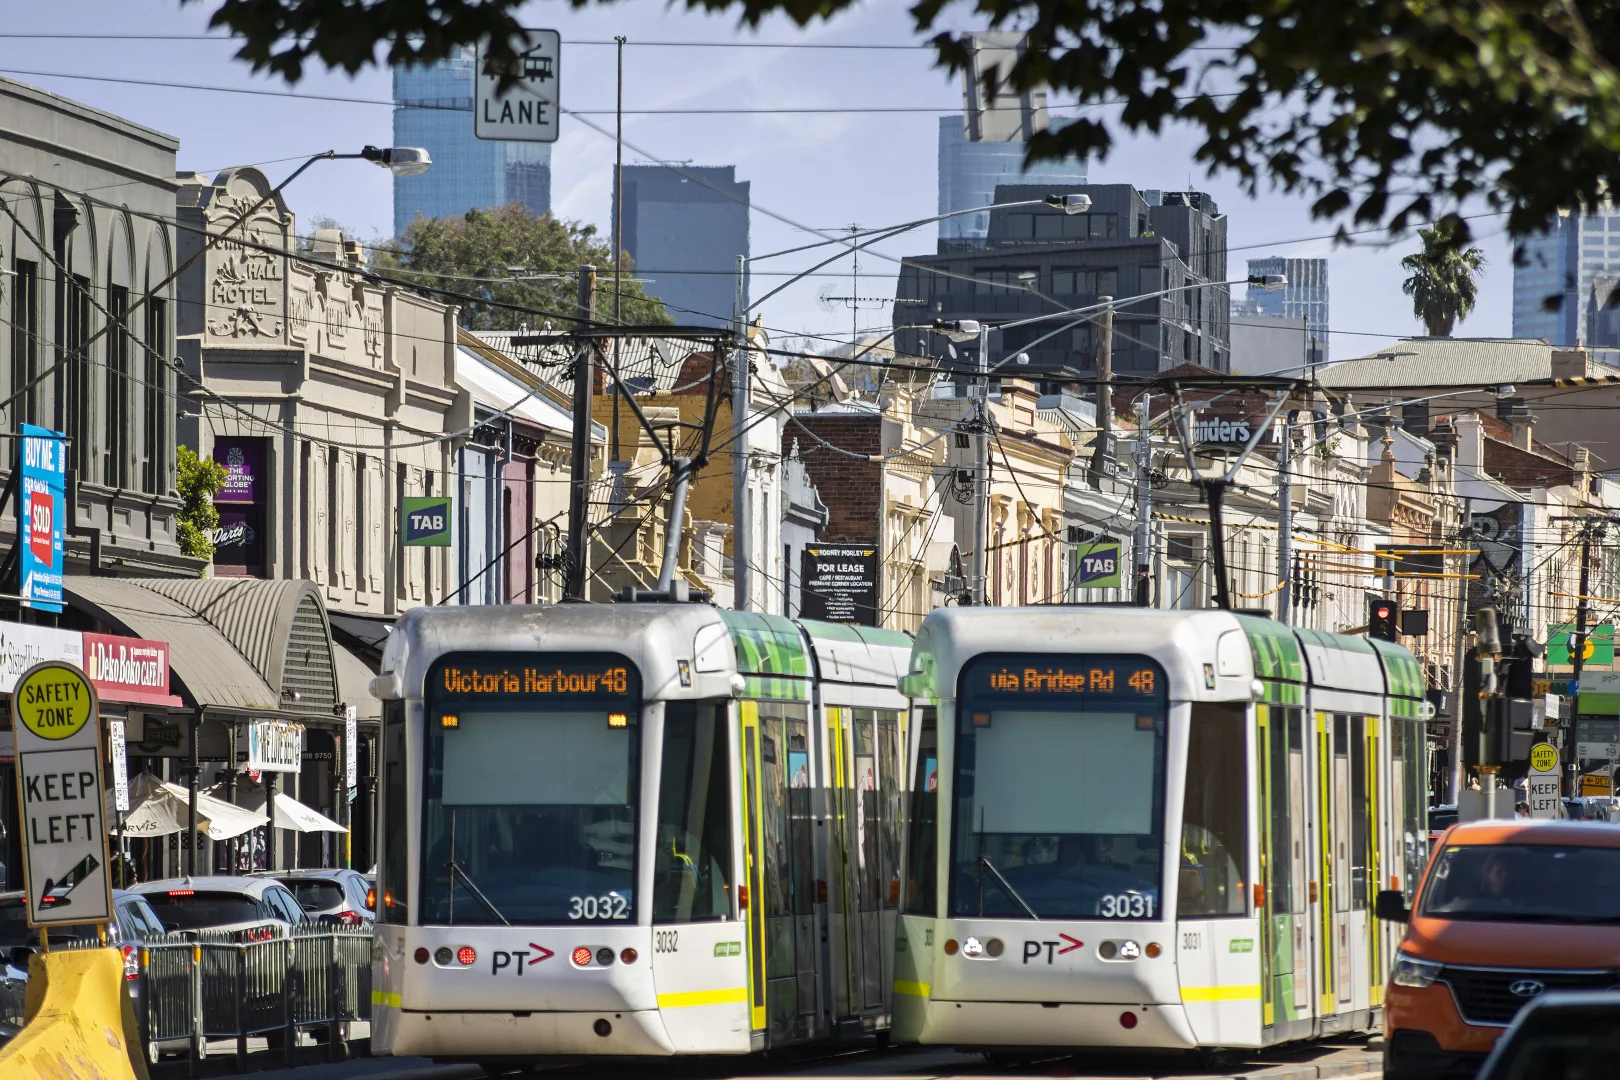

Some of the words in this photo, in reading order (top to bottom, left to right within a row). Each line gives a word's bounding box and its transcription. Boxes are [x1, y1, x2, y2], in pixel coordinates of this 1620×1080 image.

[485, 99, 549, 125] LANE
[247, 263, 283, 281] HALL
[212, 285, 277, 304] HOTEL
[26, 437, 40, 468] BUY
[33, 504, 50, 534] SOLD
[411, 515, 444, 530] TAB
[213, 526, 244, 544] Darts
[817, 564, 835, 572] FOR
[837, 564, 864, 573] LEASE
[1084, 559, 1115, 573] TAB
[444, 668, 520, 693] Victoria
[525, 668, 599, 693] Harbour
[600, 668, 627, 692] 48
[990, 669, 1019, 690] via
[1024, 669, 1085, 693] Bridge
[1089, 669, 1115, 691] Rd
[1129, 670, 1155, 693] 48
[26, 683, 81, 705] SAFETY
[37, 708, 75, 728] ZONE
[1533, 750, 1554, 758] SAFETY
[1605, 748, 1616, 756] 19
[26, 772, 95, 802] KEEP
[1531, 784, 1558, 794] KEEP
[1533, 799, 1557, 810] LEFT
[32, 813, 95, 845] LEFT
[568, 896, 628, 920] 3032
[1102, 895, 1154, 918] 3031
[655, 930, 678, 953] 3032
[1023, 940, 1059, 964] PT
[1183, 932, 1201, 950] 3031
[492, 951, 530, 976] PT
